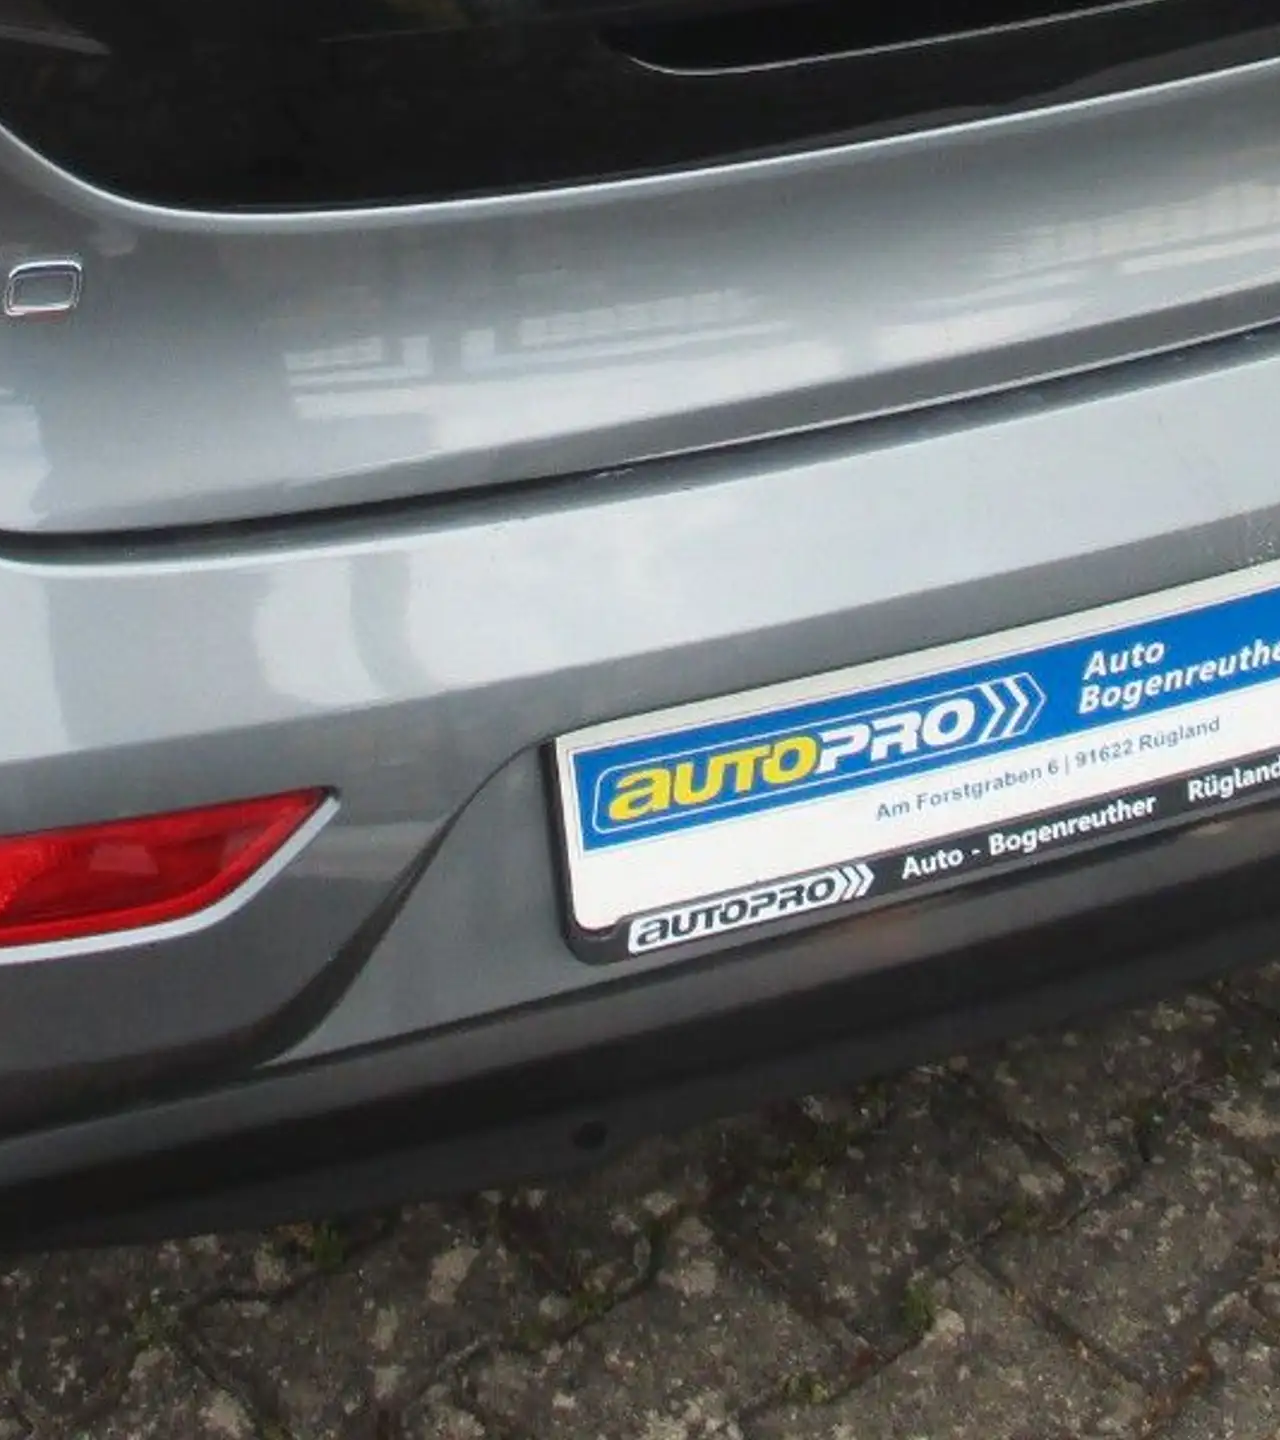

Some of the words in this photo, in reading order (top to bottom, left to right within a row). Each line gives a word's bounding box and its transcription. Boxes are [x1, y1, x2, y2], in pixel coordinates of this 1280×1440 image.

[1083, 638, 1166, 681] Auto
[876, 800, 911, 822] Am
[916, 764, 1043, 811] Forstgraben
[1047, 759, 1060, 776] 6
[1074, 736, 1135, 771] 91622
[1138, 716, 1221, 754] Rügland
[901, 847, 965, 880] Auto
[988, 794, 1157, 857] Bogenreuther
